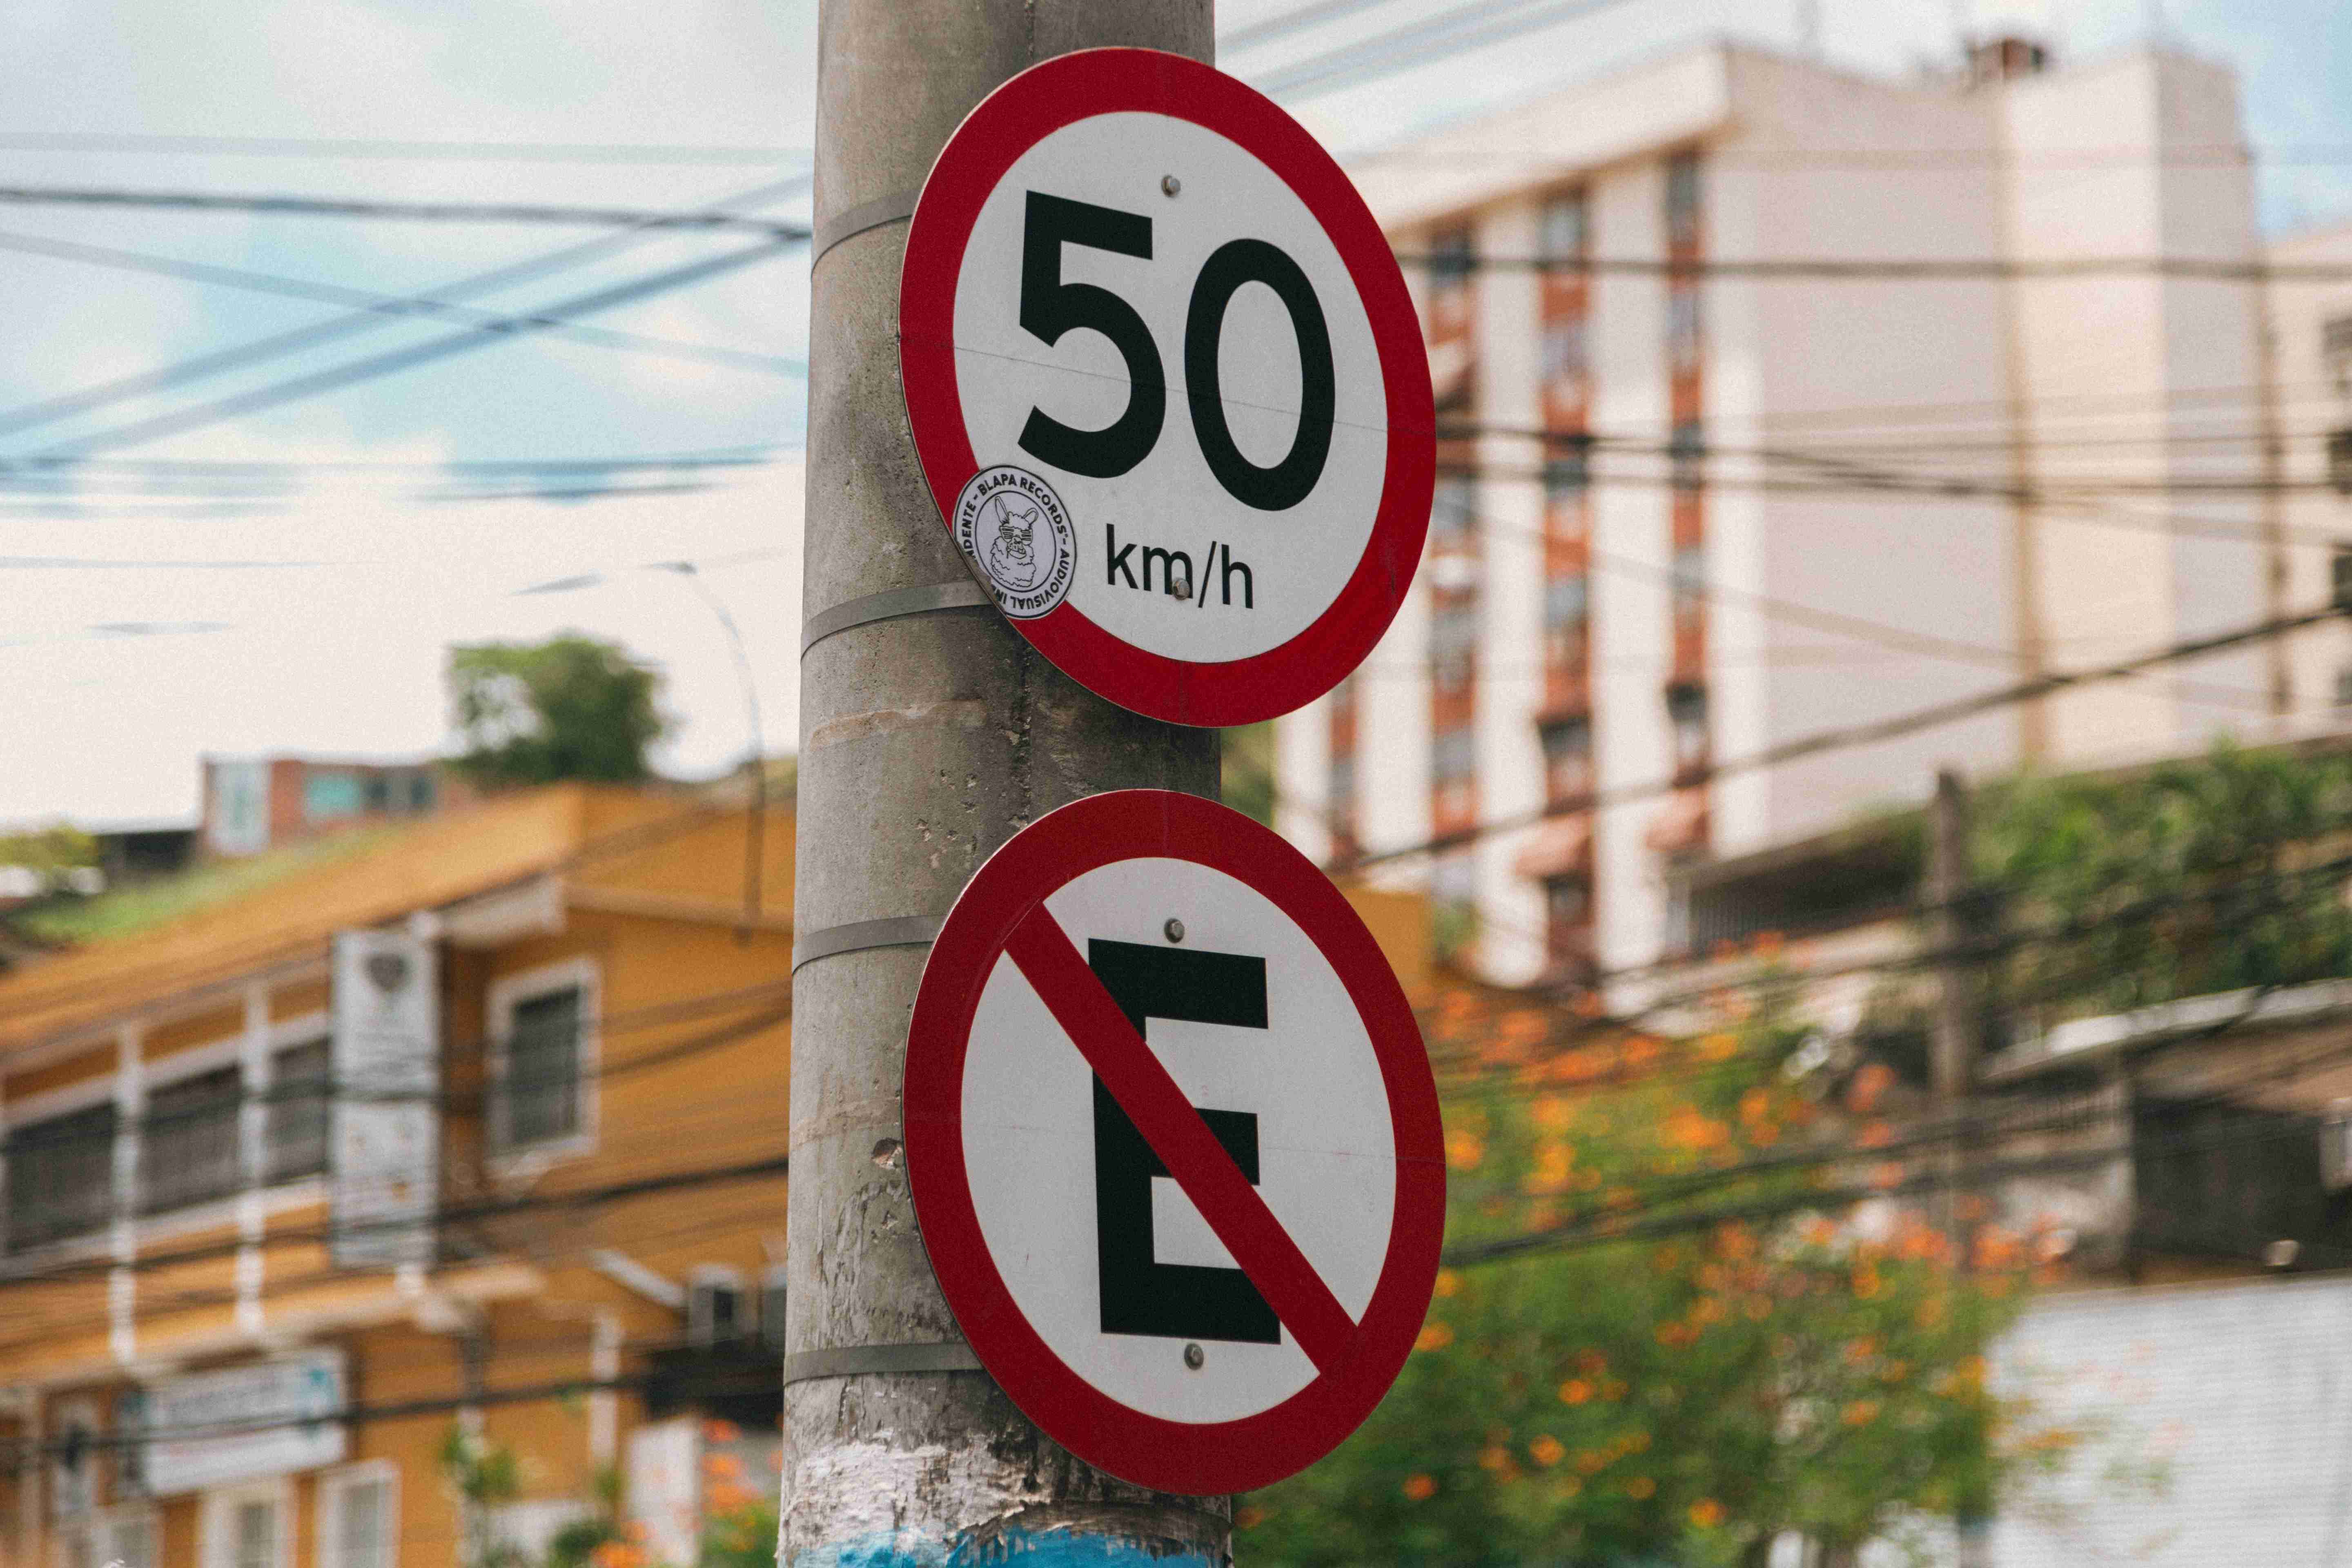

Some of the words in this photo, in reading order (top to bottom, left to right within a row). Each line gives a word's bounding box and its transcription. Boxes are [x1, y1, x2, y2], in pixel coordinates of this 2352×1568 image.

[1017, 190, 1335, 511] 50
[977, 474, 1017, 496] BLAPA
[1010, 548, 1069, 610] AUDIOVISUAL
[1106, 523, 1253, 609] km/h
[1088, 938, 1281, 1345] E
